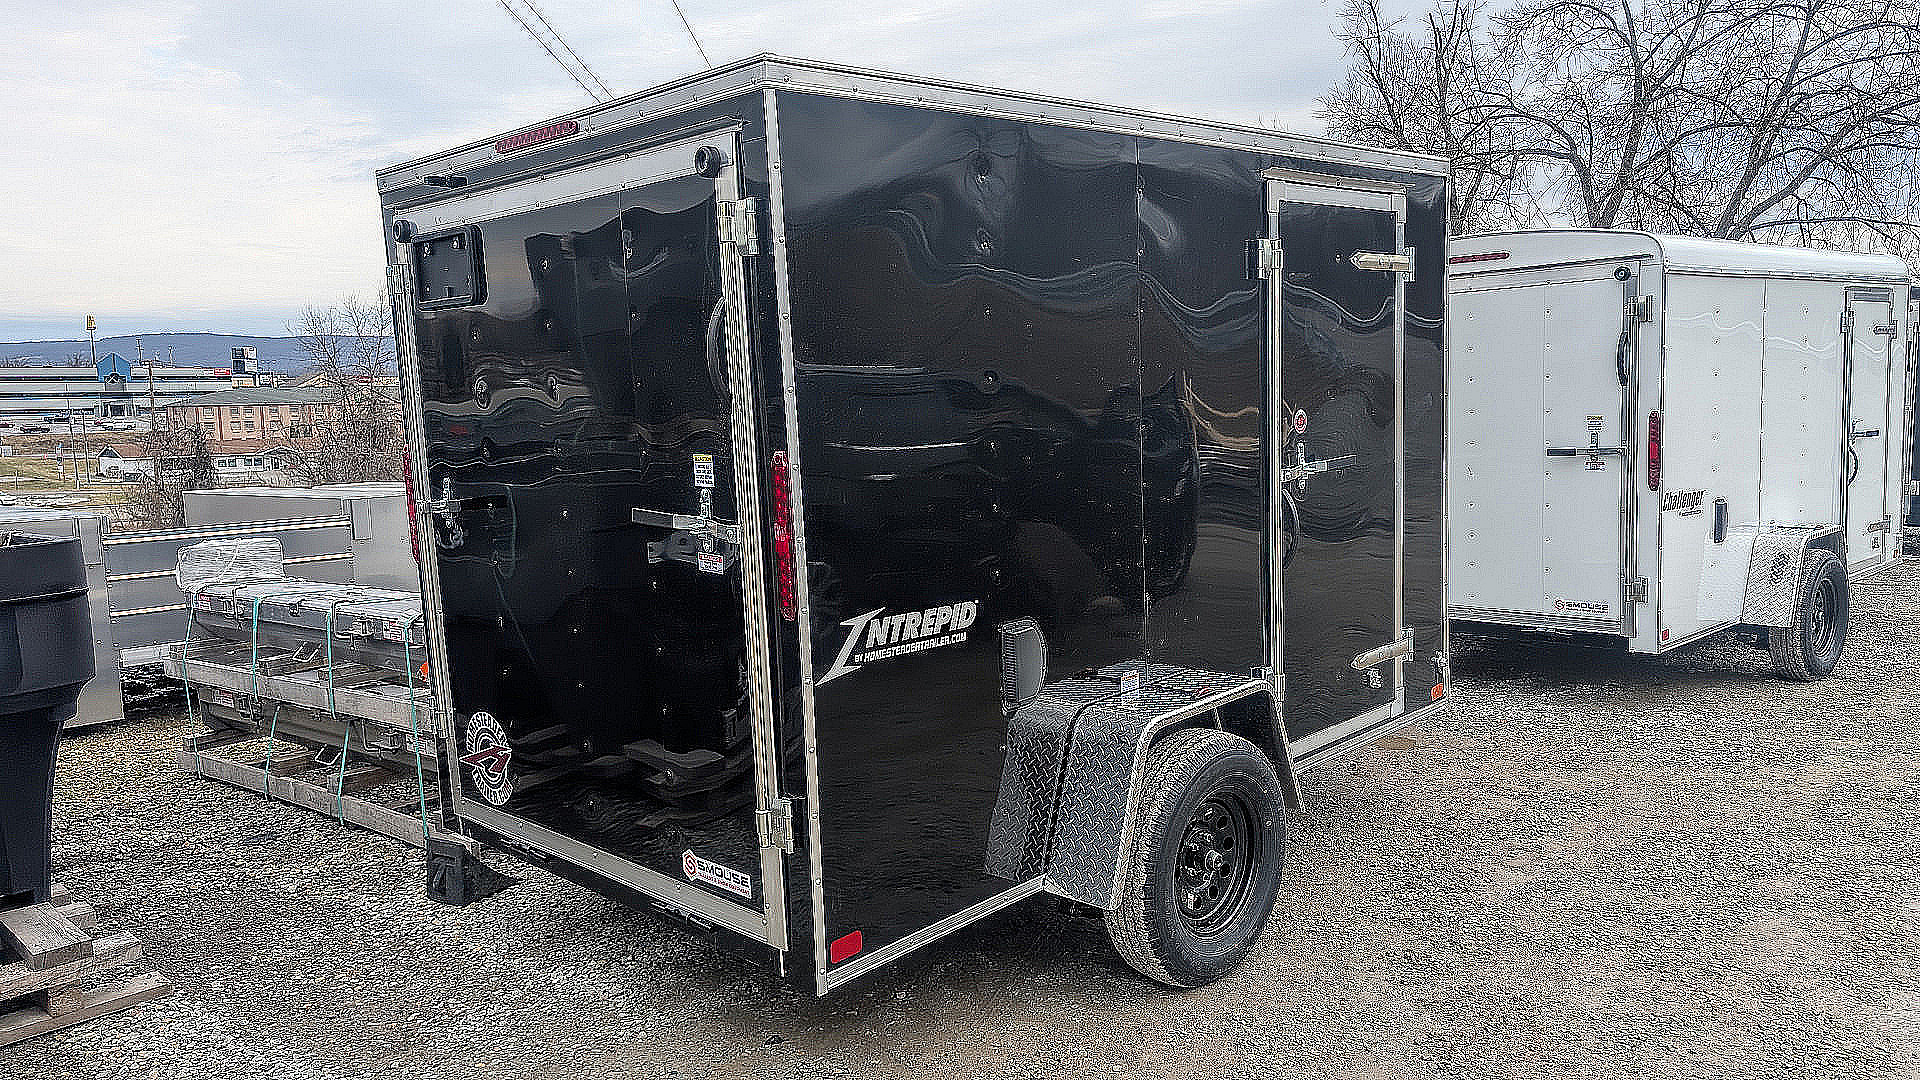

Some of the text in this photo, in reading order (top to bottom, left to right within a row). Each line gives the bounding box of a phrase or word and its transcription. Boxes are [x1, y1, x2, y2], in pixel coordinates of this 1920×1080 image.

[1663, 490, 1705, 511] Challenger
[815, 601, 977, 686] INTREPID
[864, 632, 967, 662] HOMESTEADERTRAILER.COM
[467, 712, 507, 752] HOMESTEADER
[697, 860, 750, 889] SMOUSE
